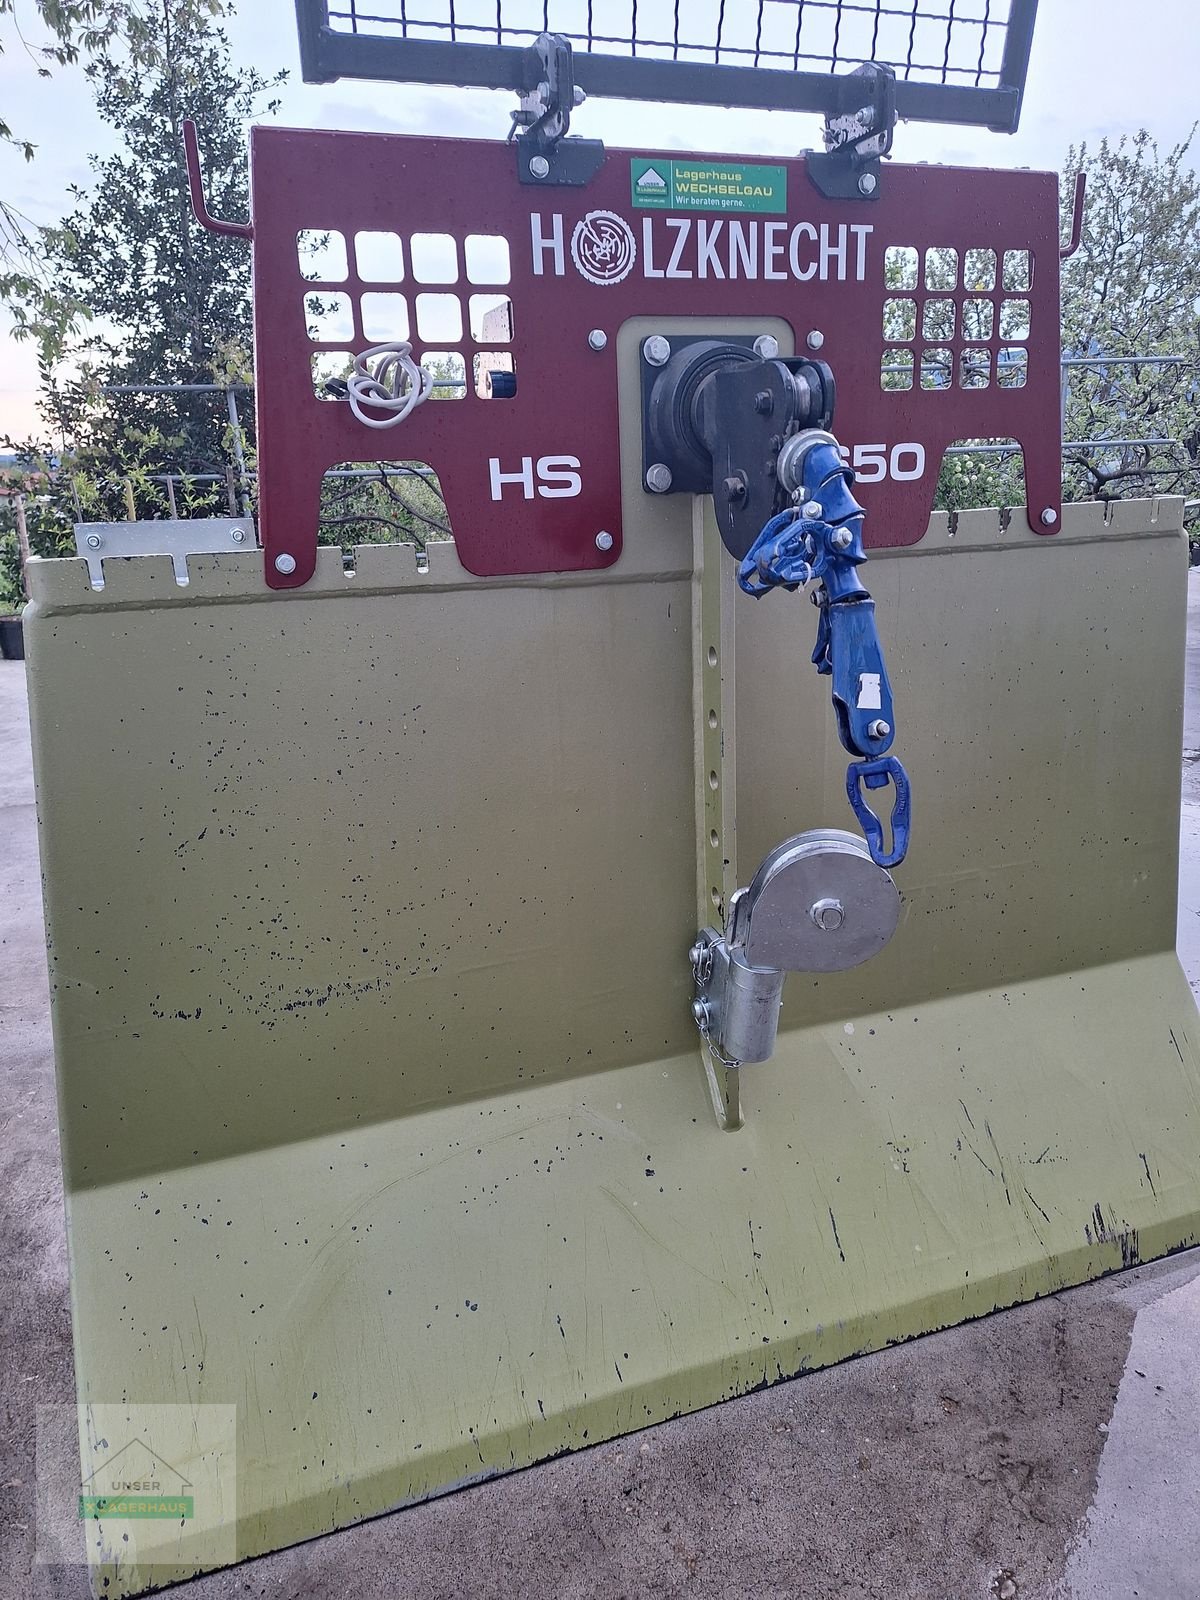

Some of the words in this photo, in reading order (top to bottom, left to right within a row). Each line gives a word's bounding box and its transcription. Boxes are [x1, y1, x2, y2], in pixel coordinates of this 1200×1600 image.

[675, 168, 742, 181] Lagerhaus
[675, 183, 773, 197] WECHSELGAU
[675, 196, 689, 206] Wir
[690, 197, 720, 206] beraten
[721, 199, 745, 208] gerne.
[530, 209, 874, 286] HOLZKNECHT
[489, 455, 582, 500] HS
